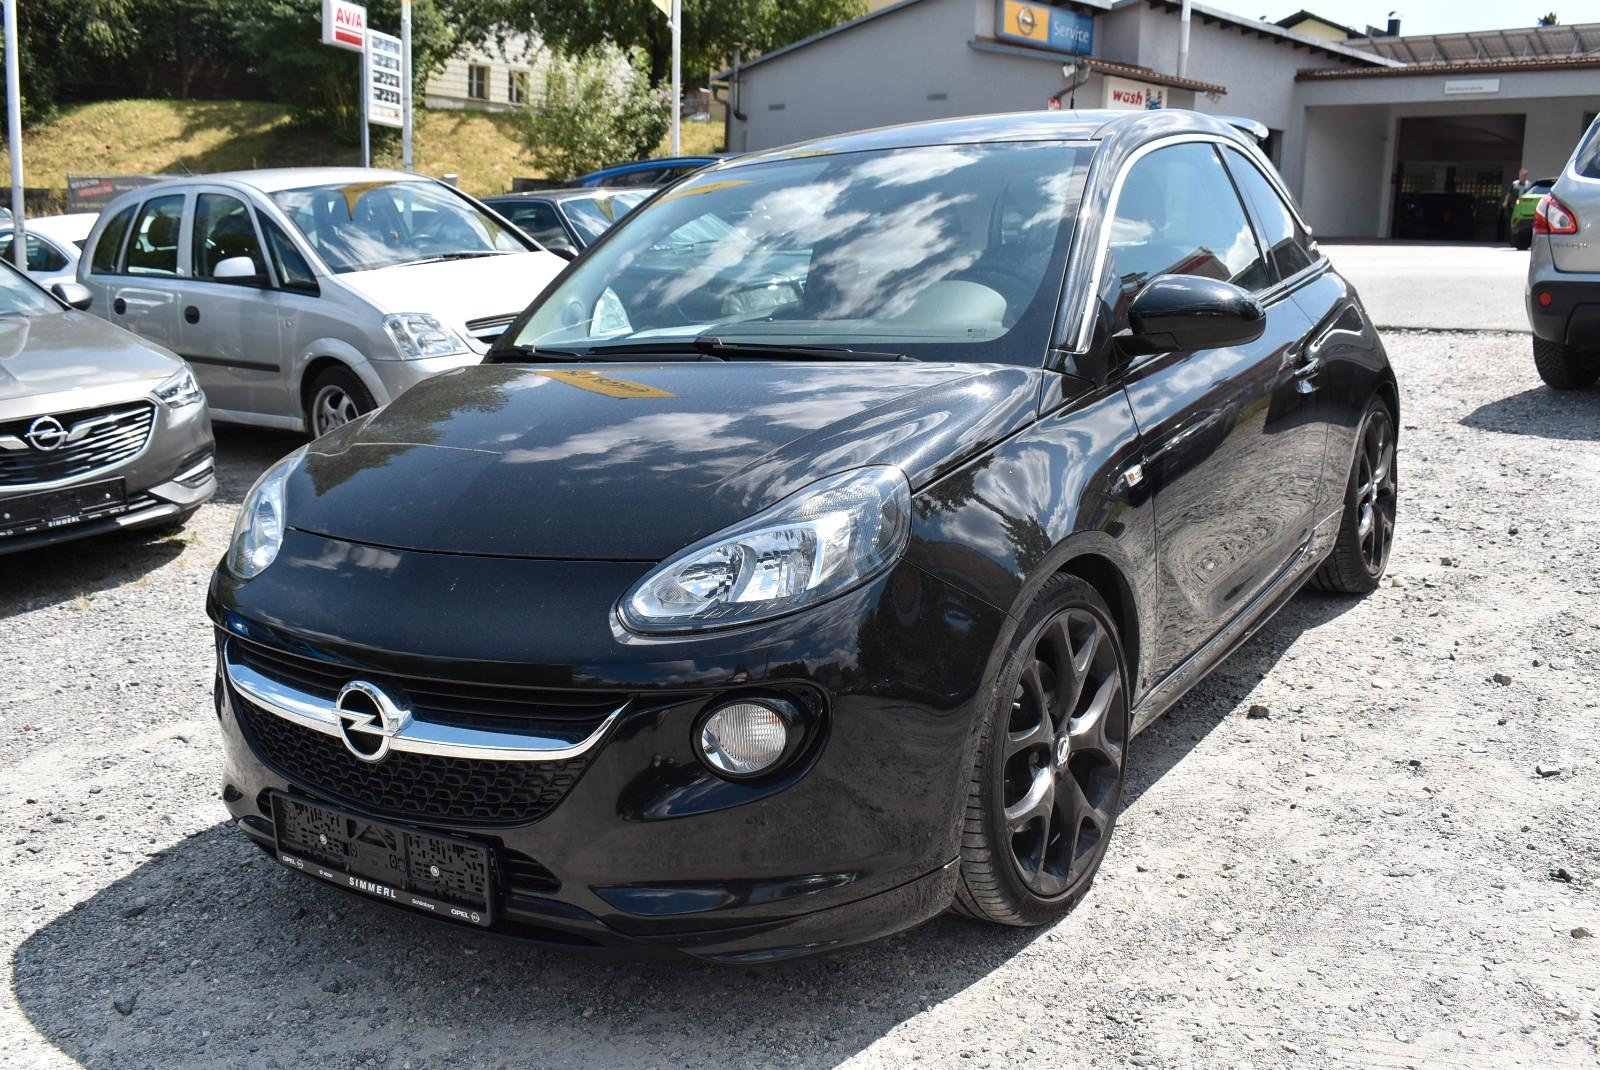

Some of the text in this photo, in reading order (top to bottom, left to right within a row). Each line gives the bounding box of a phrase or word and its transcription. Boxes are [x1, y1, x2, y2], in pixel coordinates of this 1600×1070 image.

[335, 7, 363, 29] AVIA
[1054, 20, 1090, 43] Service
[1113, 89, 1143, 105] wash
[282, 855, 297, 865] OPEL
[348, 876, 397, 899] SIMMERL
[450, 908, 470, 919] OPEL
